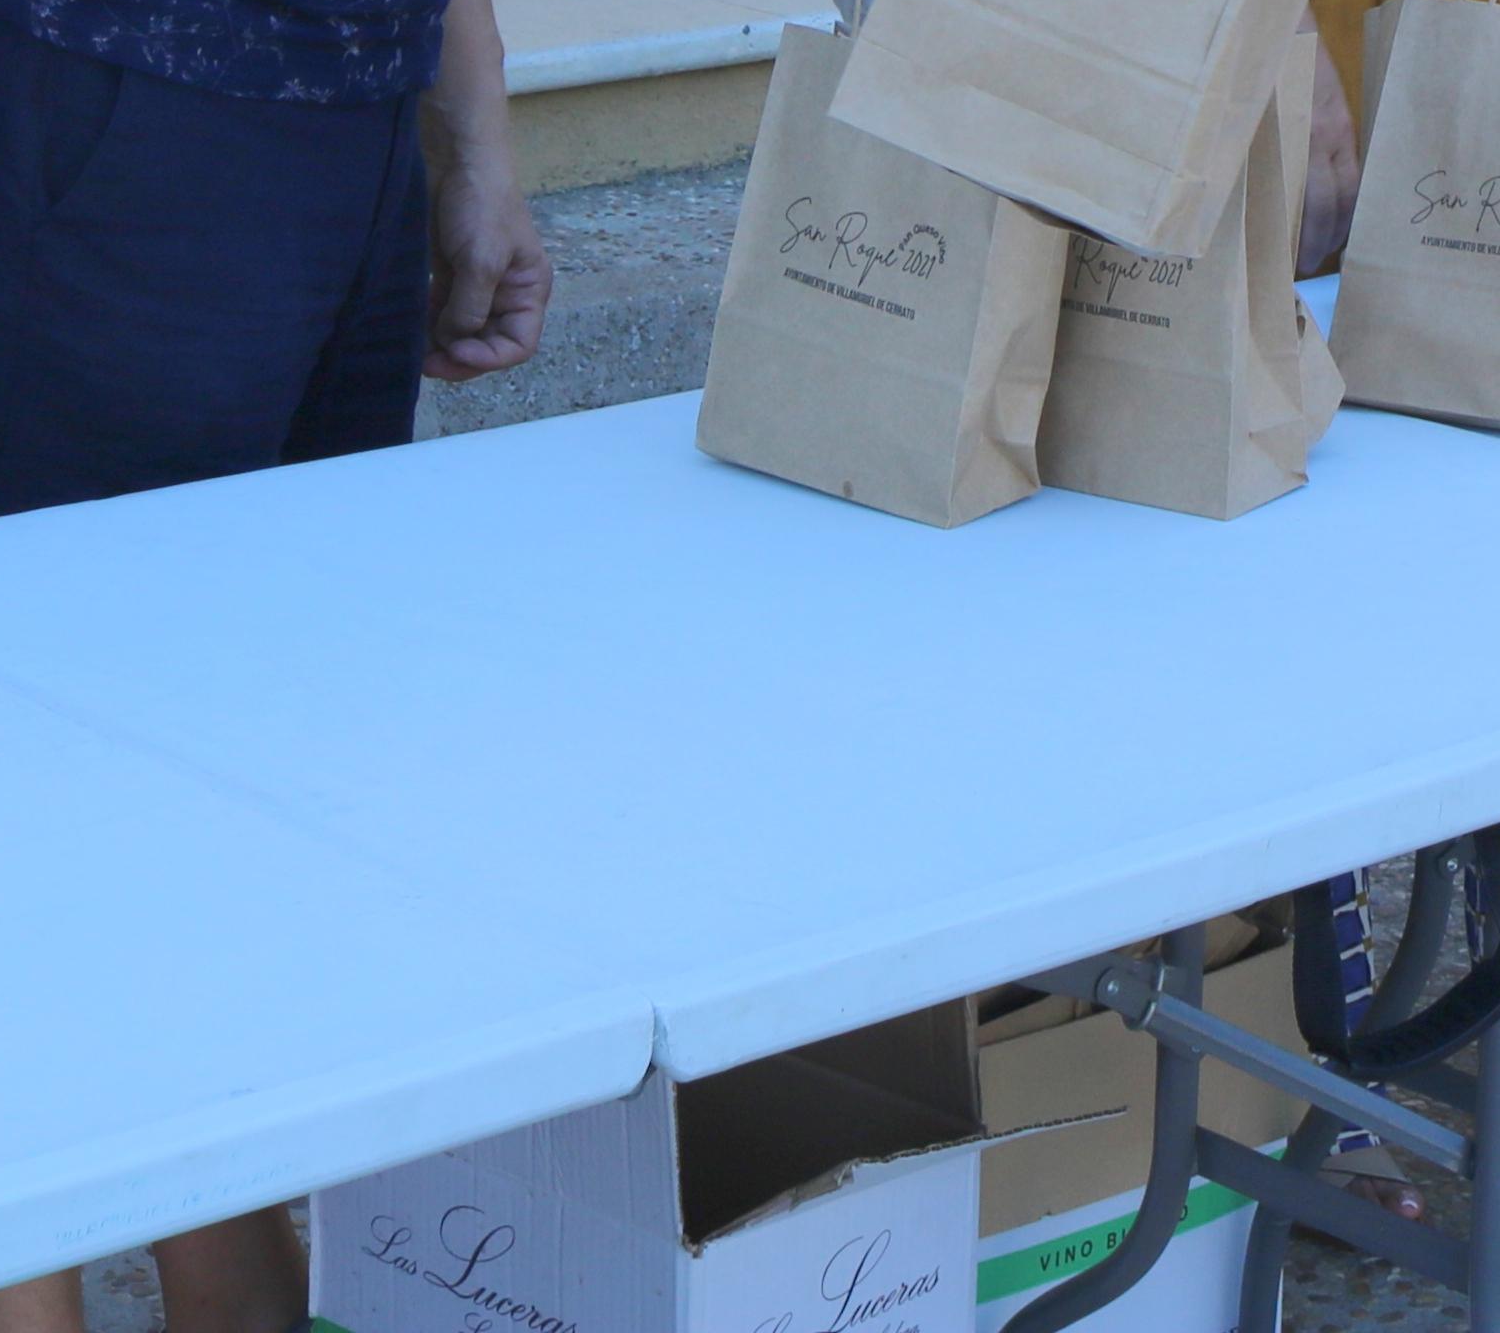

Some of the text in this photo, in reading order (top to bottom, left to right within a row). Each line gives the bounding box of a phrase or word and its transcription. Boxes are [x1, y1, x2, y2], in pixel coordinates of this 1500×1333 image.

[1410, 169, 1468, 225] San
[779, 196, 937, 288] San Roque 2021
[1072, 235, 1184, 304] Roque 2021
[1420, 235, 1476, 253] AYUNTAMIENTO
[1476, 241, 1487, 254] DE
[783, 267, 827, 291] AYUNTAMIENTO
[826, 282, 836, 295] DE
[876, 297, 885, 311] DE
[361, 1214, 418, 1276] Las
[1039, 1239, 1093, 1272] VINO
[815, 1229, 940, 1333] Luceras
